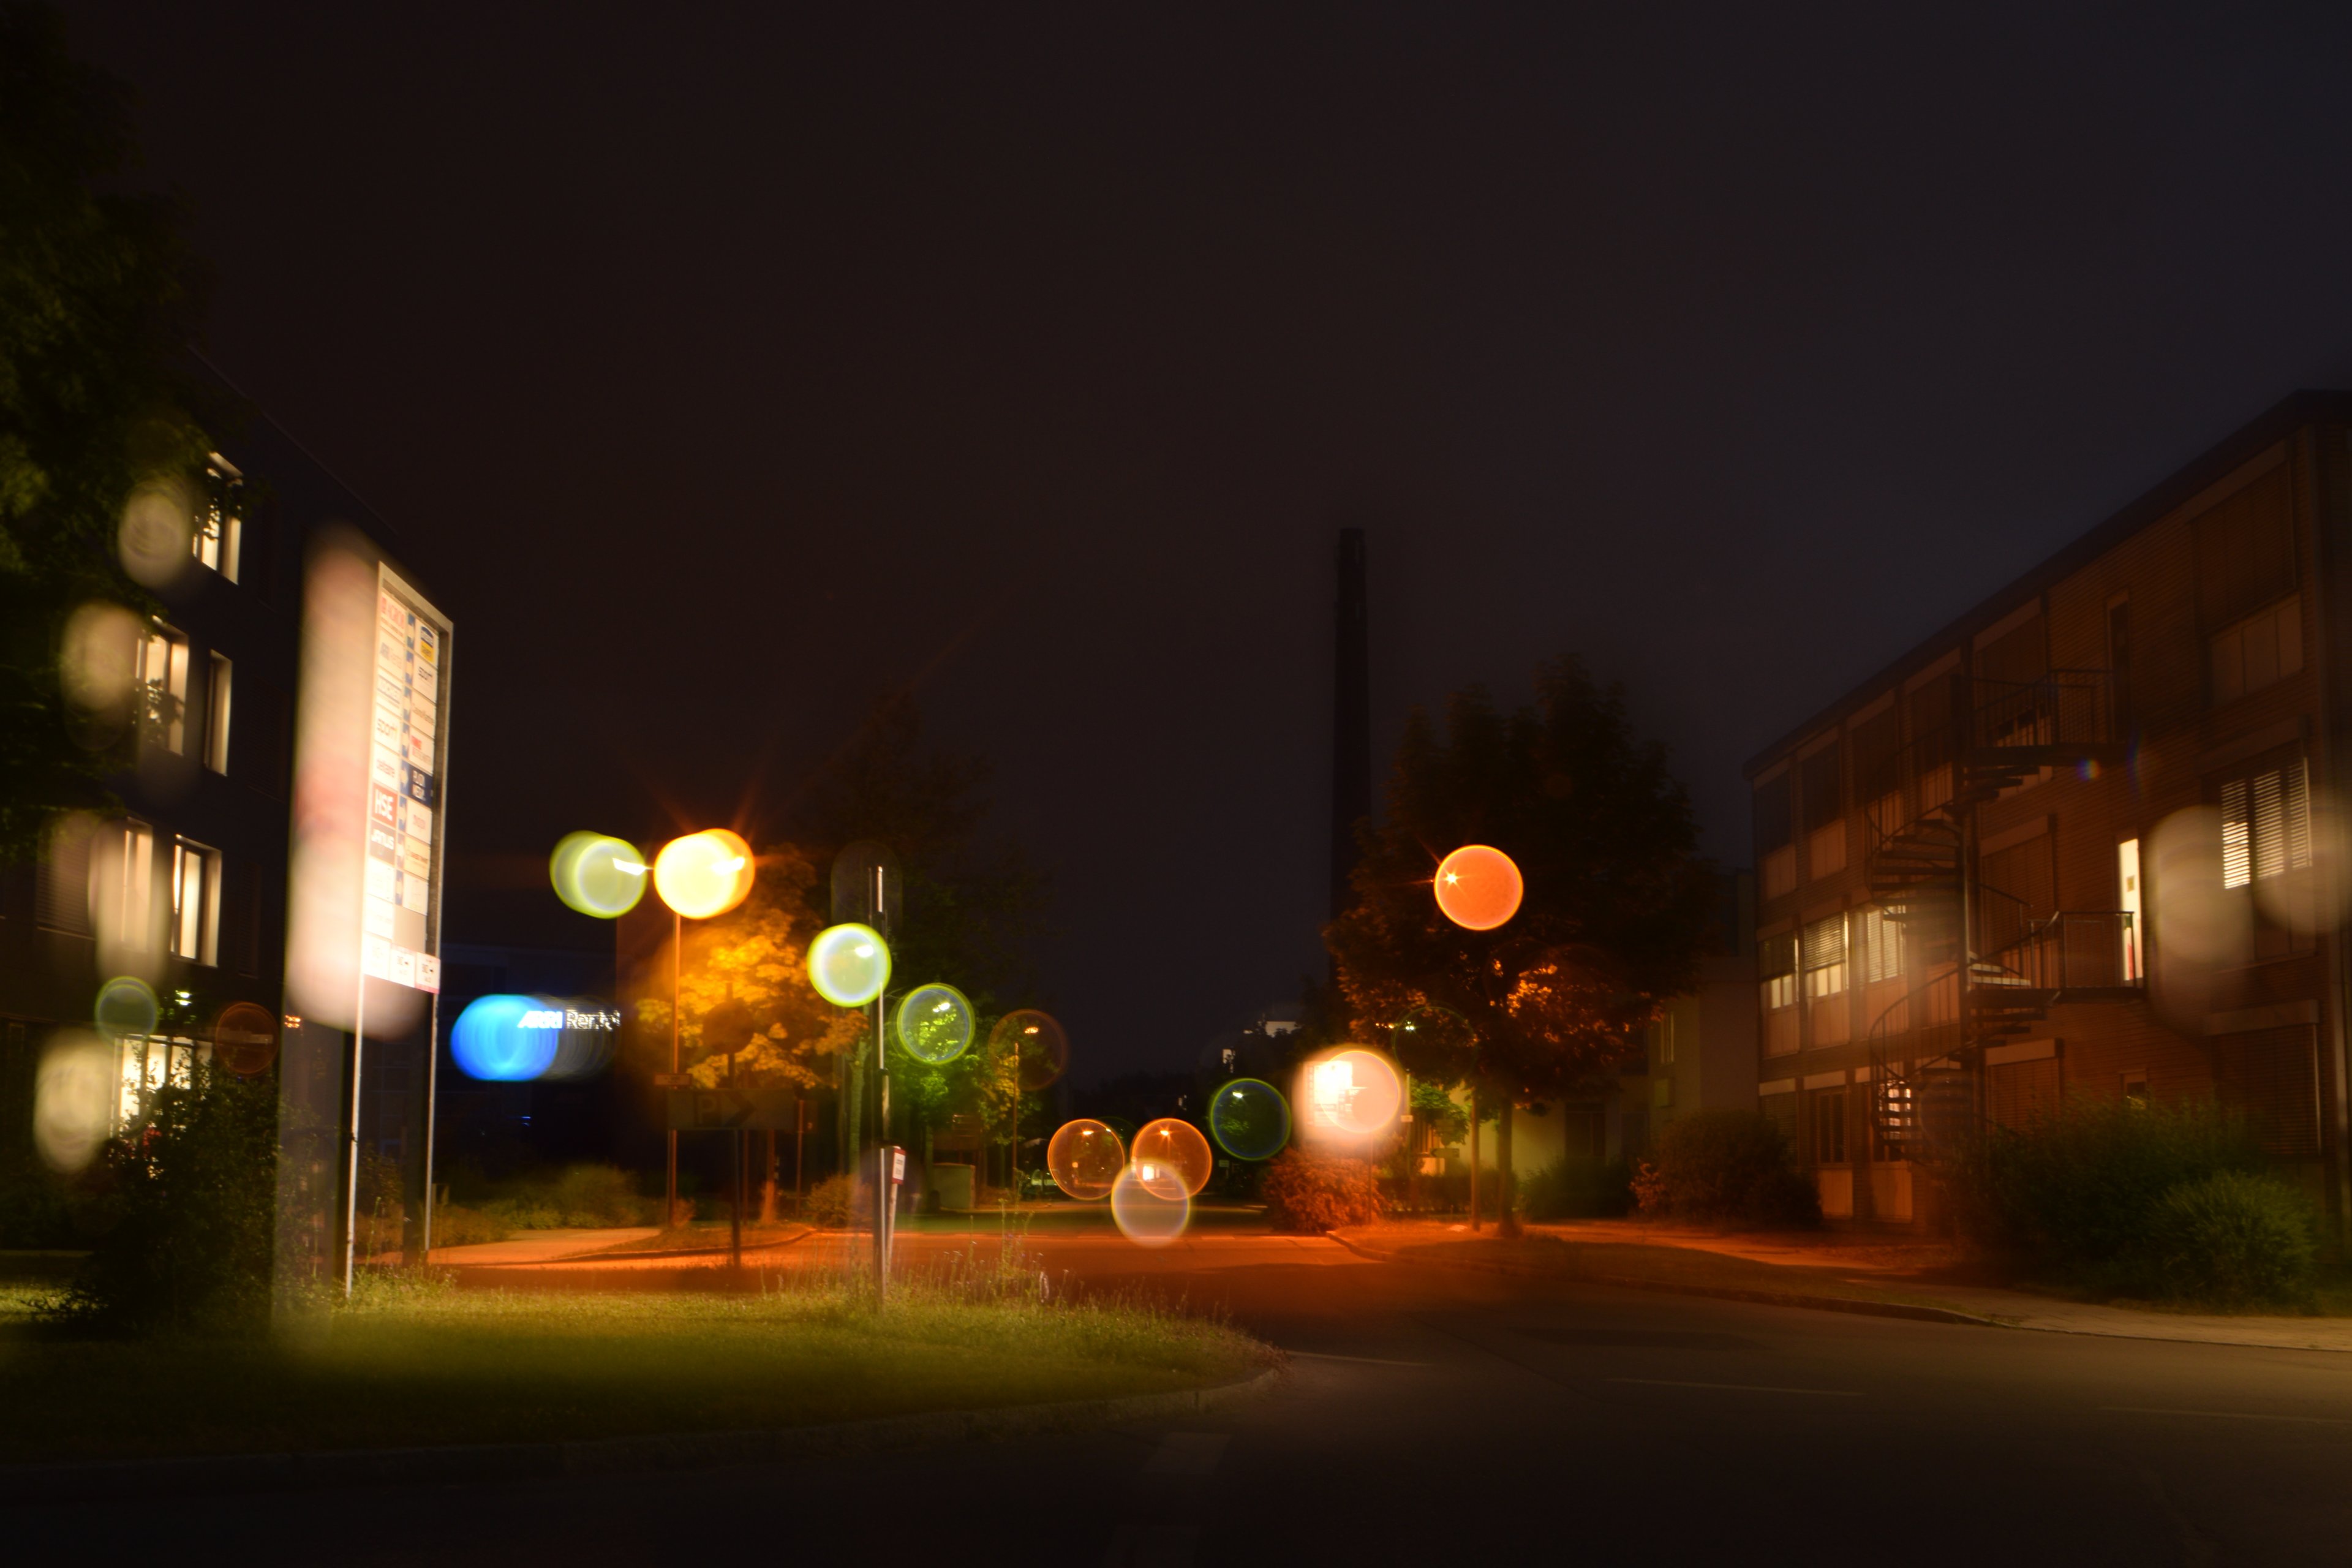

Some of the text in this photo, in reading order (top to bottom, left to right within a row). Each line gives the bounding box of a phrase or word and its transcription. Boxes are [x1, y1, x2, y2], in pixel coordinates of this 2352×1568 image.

[374, 788, 394, 821] HSE
[517, 1010, 563, 1029] ARRI
[698, 1095, 717, 1125] P
